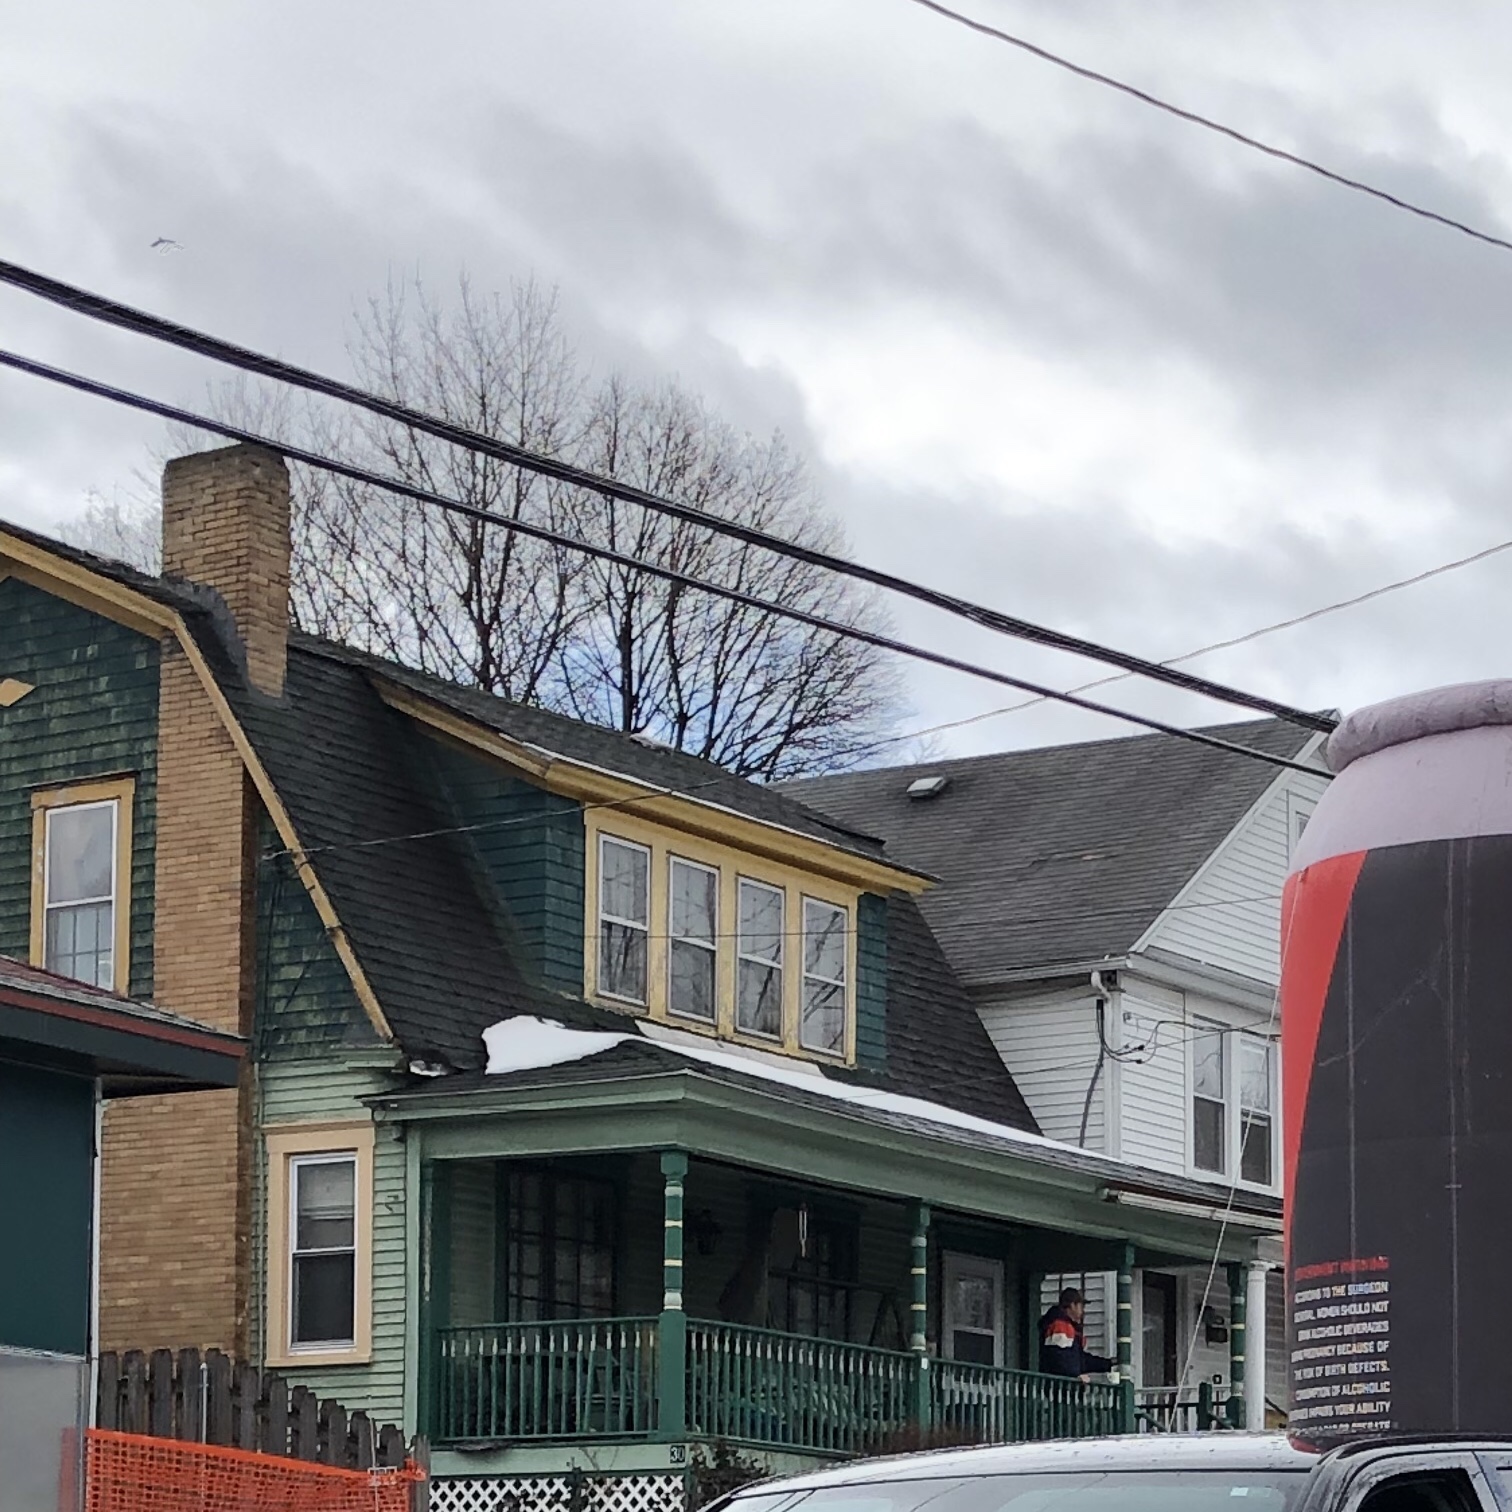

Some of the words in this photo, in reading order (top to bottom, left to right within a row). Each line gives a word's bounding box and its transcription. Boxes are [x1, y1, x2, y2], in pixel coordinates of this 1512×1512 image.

[1336, 1340, 1375, 1356] BECAUSE
[1376, 1340, 1391, 1353] OF
[1341, 1380, 1391, 1396] ALCOHOLIC
[1356, 1400, 1391, 1415] ABILITY
[670, 1446, 685, 1462] 30
